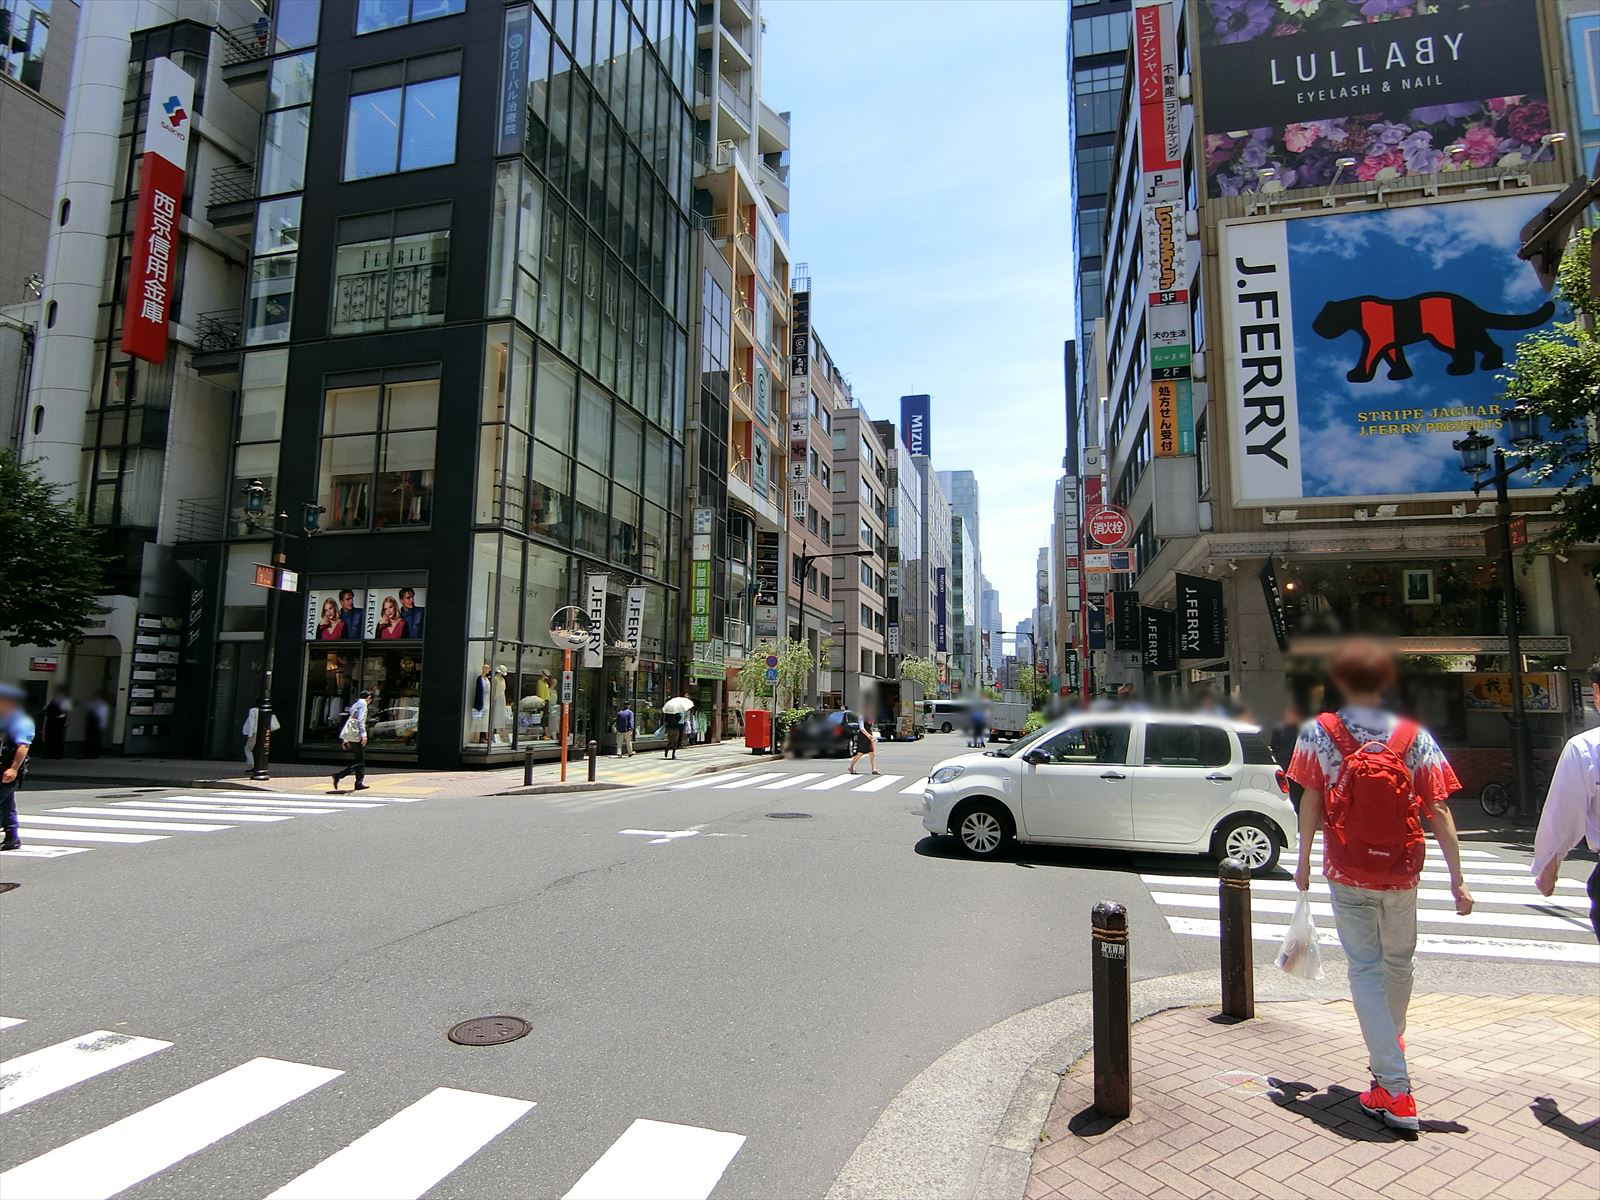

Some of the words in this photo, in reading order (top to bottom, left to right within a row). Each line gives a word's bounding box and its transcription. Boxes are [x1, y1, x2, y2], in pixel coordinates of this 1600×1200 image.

[1141, 10, 1157, 99] ピュアジャパン
[1269, 32, 1465, 85] LULLABY
[1296, 83, 1372, 104] EYELASH
[1381, 80, 1392, 92] &
[1401, 74, 1443, 90] NAIL
[160, 120, 186, 141] SAIKYO
[141, 188, 176, 325] 西京信用金庫
[1161, 292, 1175, 302] 3F
[1152, 329, 1186, 340] 犬の生活
[1235, 257, 1289, 470] J.FERRY
[1158, 386, 1173, 452] 処方せん受付
[1358, 408, 1424, 423] STRIPE
[1431, 404, 1502, 419] JAGUAR
[1359, 422, 1422, 437] J.FERRY
[1426, 418, 1504, 433] PRESENTS
[1093, 521, 1124, 535] 消火栓
[309, 593, 317, 638] J.FERRY
[367, 593, 375, 638] J.FERRY
[588, 586, 603, 657] J.FERRY
[1185, 587, 1200, 652] J.FERRY
[1148, 617, 1158, 666] J.FERRY
